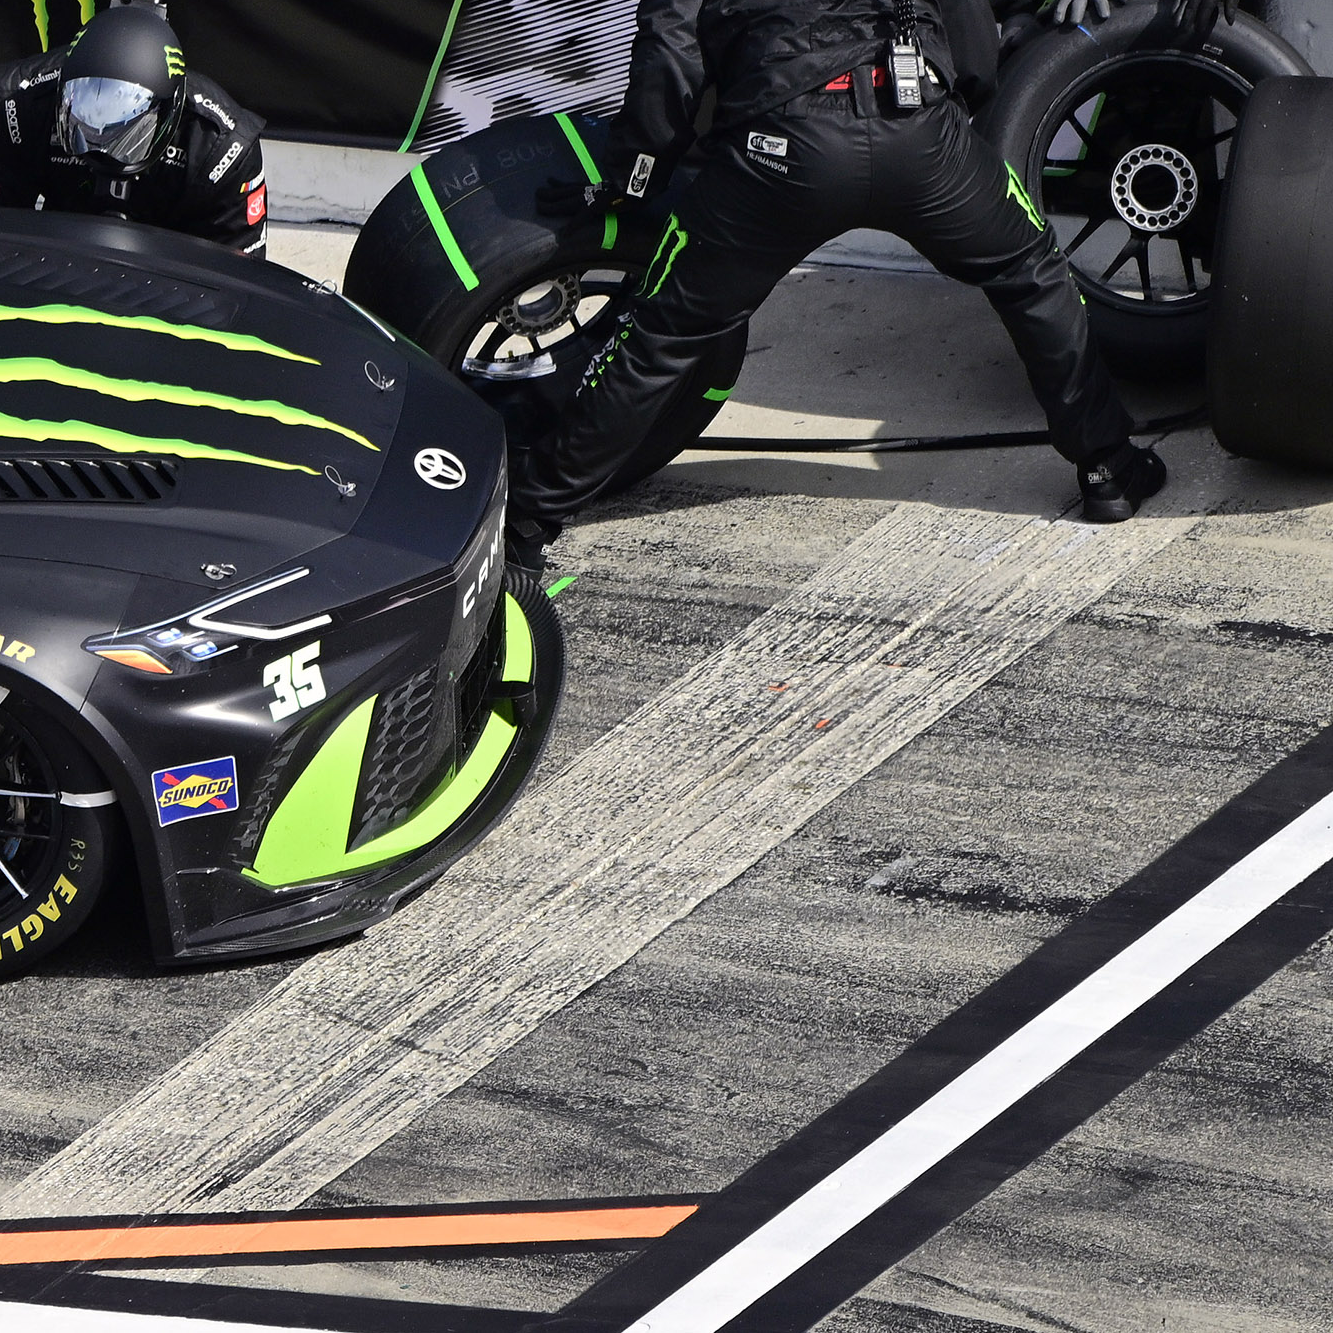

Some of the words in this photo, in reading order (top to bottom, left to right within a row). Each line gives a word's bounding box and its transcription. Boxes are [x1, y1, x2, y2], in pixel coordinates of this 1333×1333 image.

[29, 68, 61, 87] Columb
[5, 99, 22, 144] sparco
[201, 97, 236, 131] Columbia
[208, 141, 244, 185] sparco
[747, 151, 788, 175] HERMANSON
[262, 642, 326, 724] 35
[160, 779, 233, 809] SUNOCO
[70, 838, 87, 875] R35
